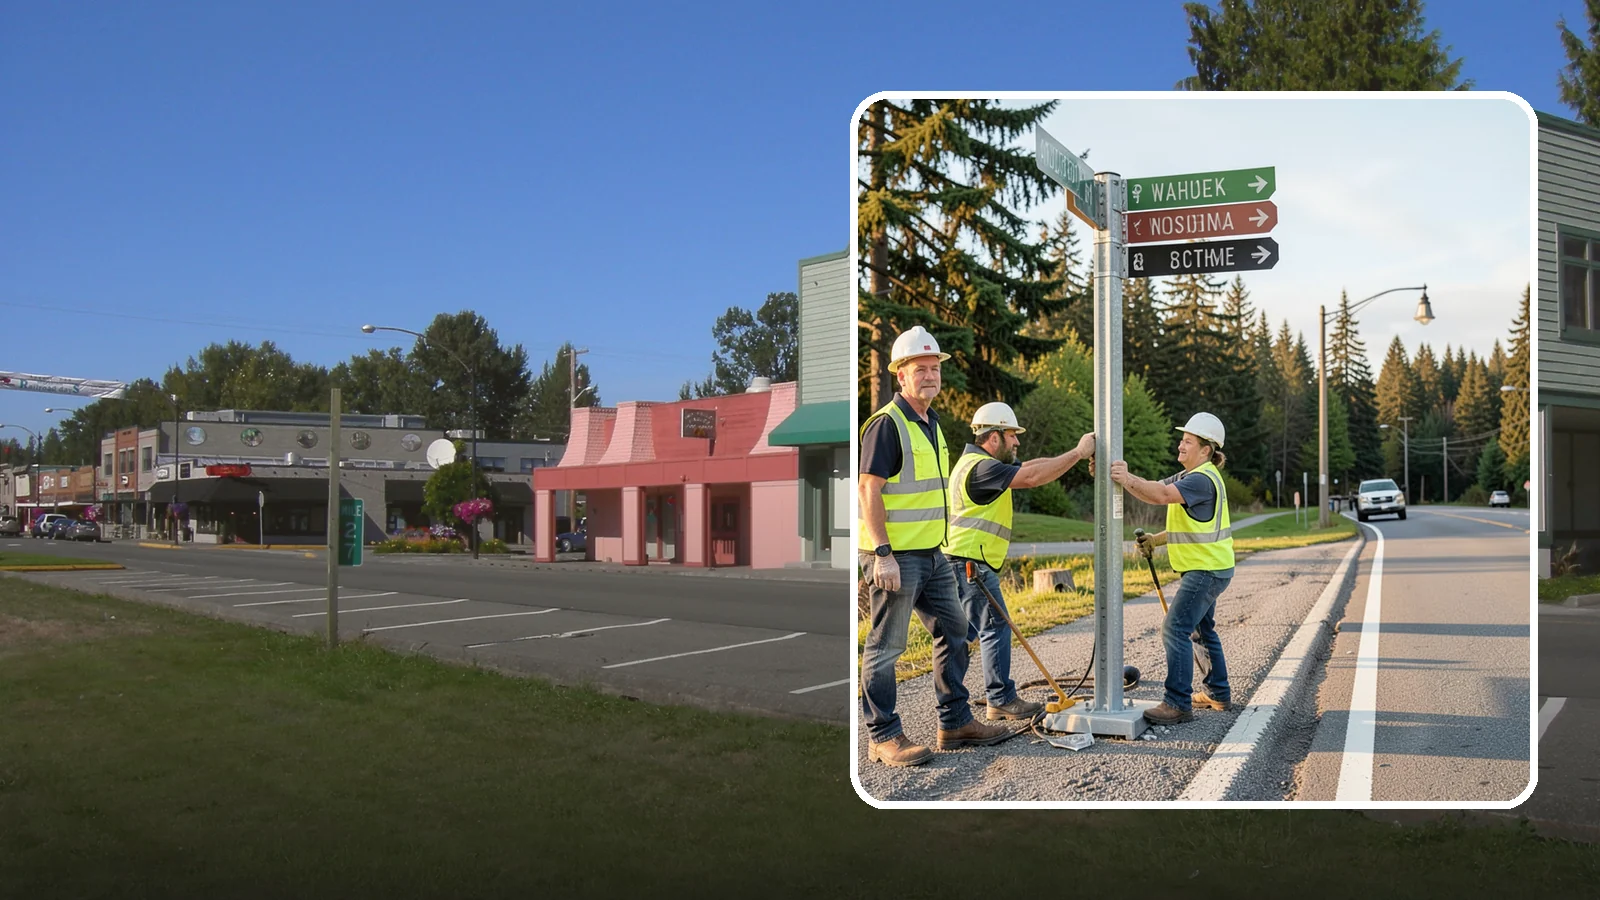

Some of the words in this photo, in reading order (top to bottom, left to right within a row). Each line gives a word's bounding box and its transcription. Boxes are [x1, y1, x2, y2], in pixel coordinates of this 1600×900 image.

[341, 505, 362, 516] MILE
[344, 522, 357, 538] 2
[344, 543, 356, 559] 7
